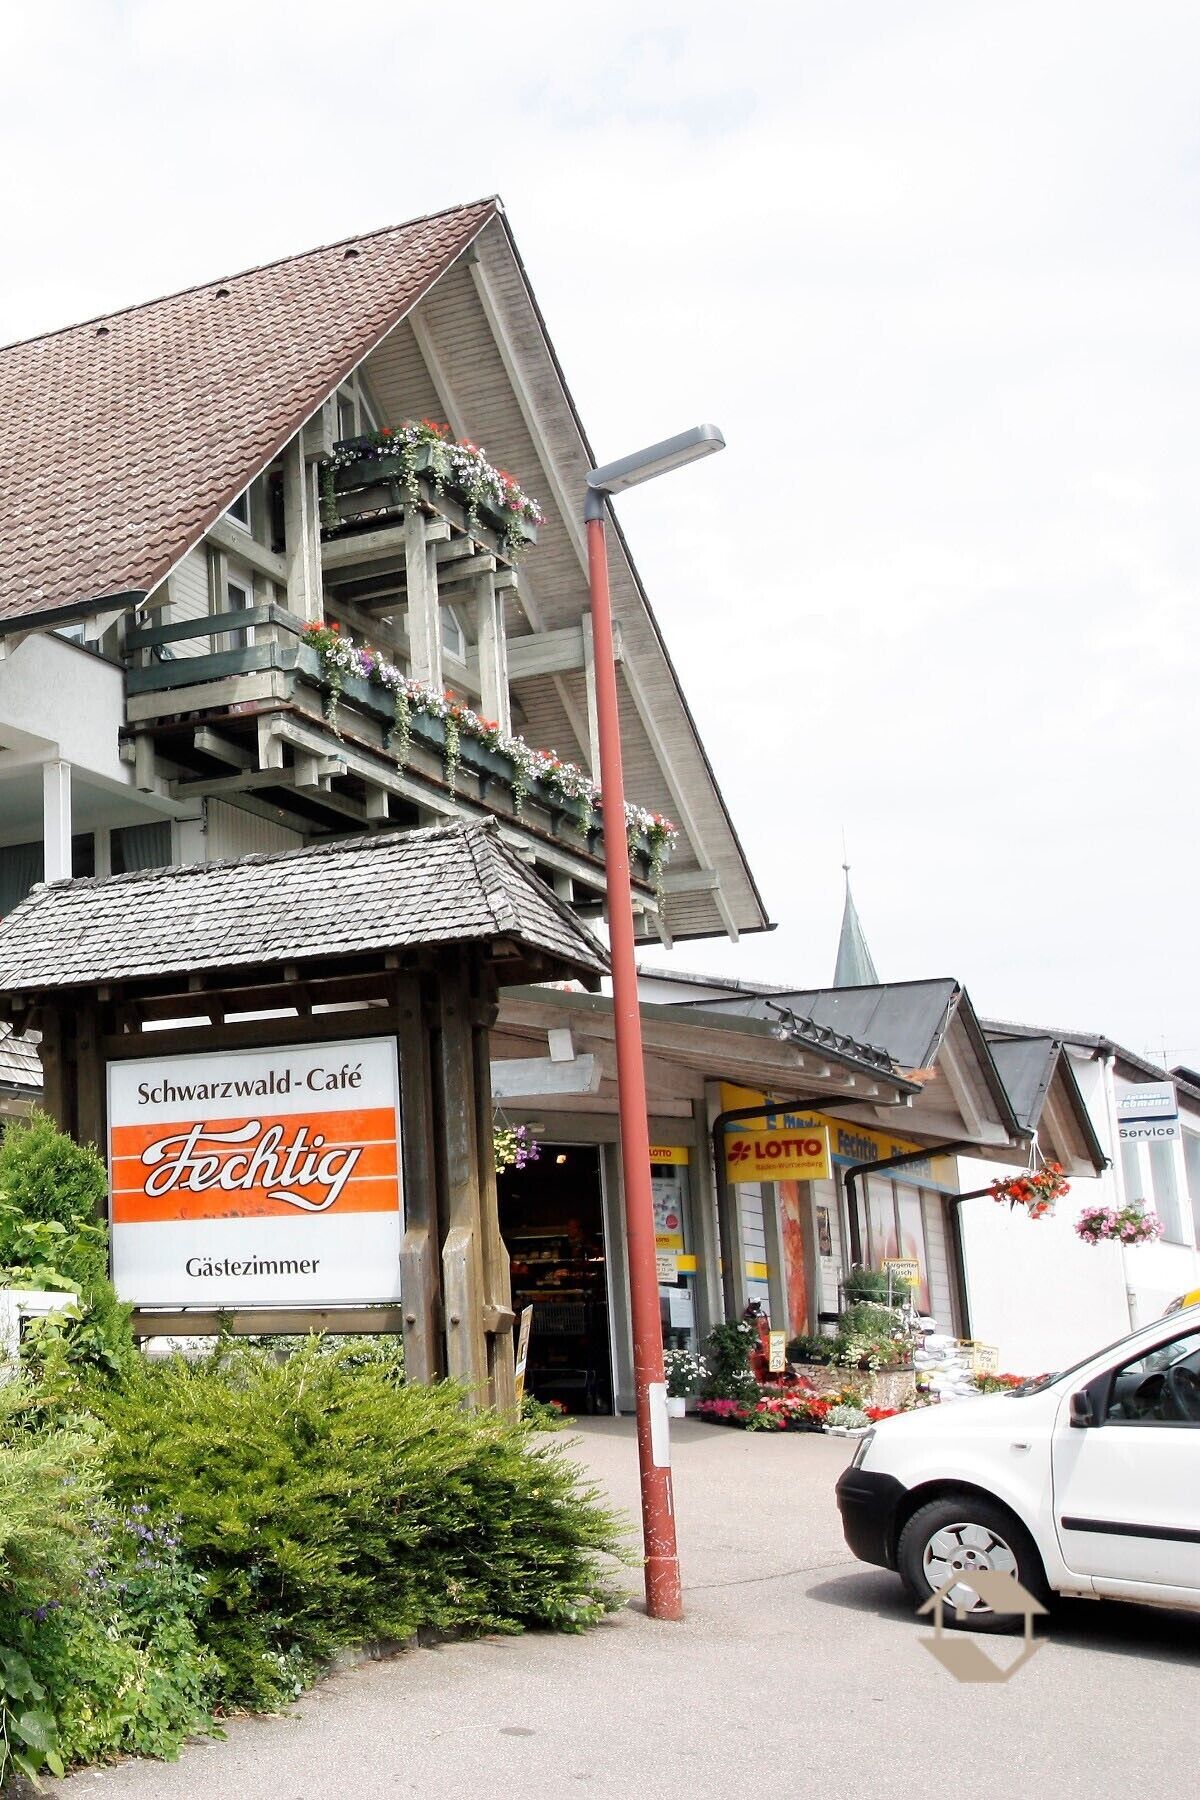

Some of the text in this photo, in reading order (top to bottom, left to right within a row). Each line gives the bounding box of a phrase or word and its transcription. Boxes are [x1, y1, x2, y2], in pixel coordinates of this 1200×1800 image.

[137, 1063, 362, 1105] Schwarzwald-Café
[1119, 1127, 1175, 1138] Service
[754, 1139, 822, 1159] LOTTO
[140, 1119, 364, 1212] Fechtig
[185, 1254, 321, 1278] Gästezimmer
